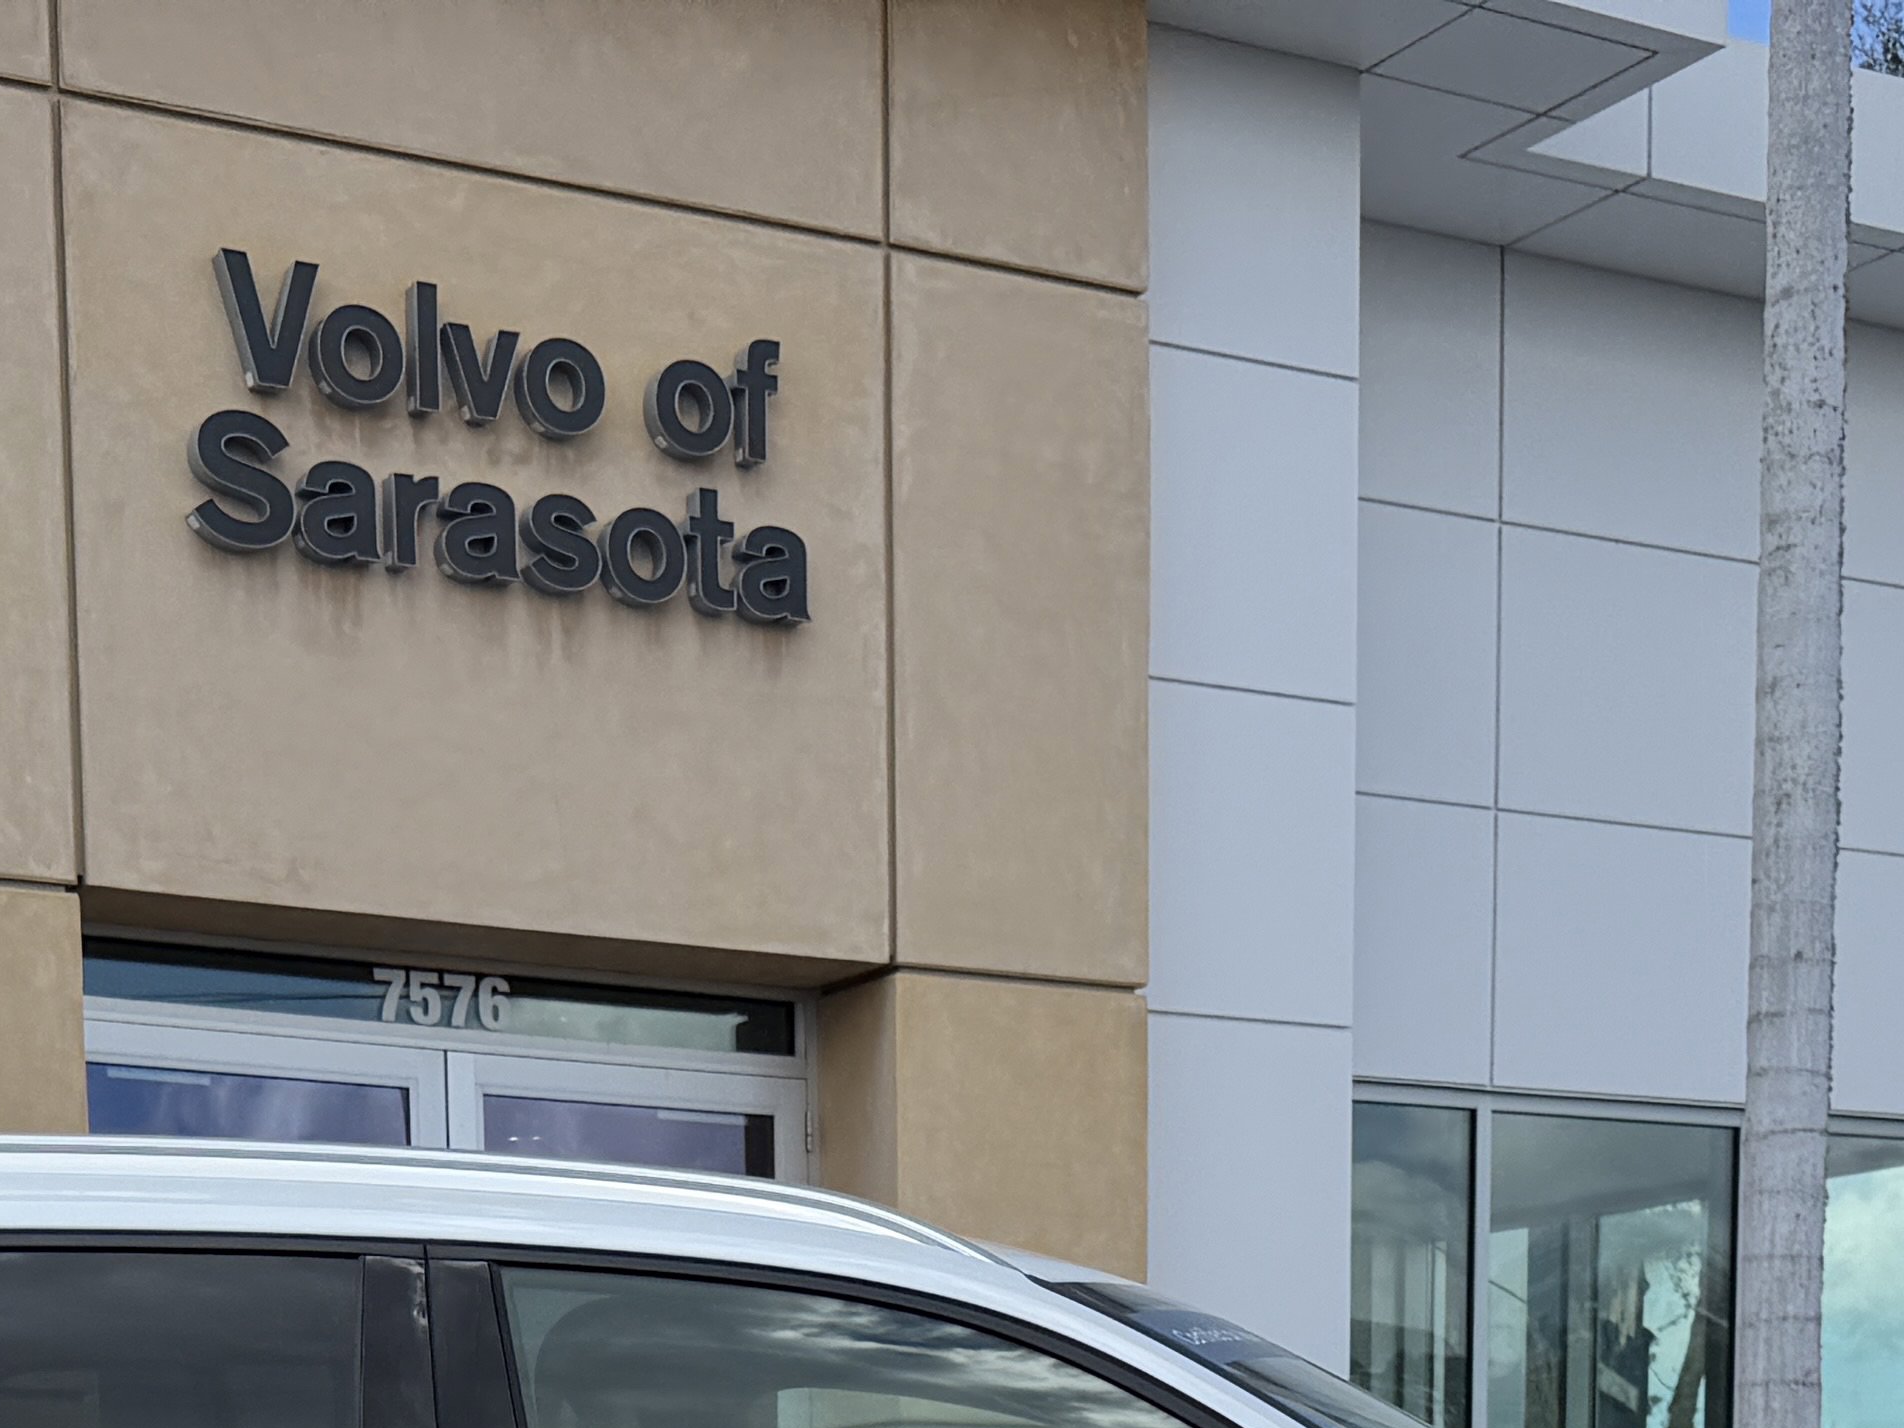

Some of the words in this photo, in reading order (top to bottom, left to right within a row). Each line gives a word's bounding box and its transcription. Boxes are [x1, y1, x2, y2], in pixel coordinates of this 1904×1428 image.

[212, 247, 606, 440] Volvo
[643, 338, 781, 469] of
[185, 408, 812, 626] Sarasota
[372, 967, 513, 1032] 7576
